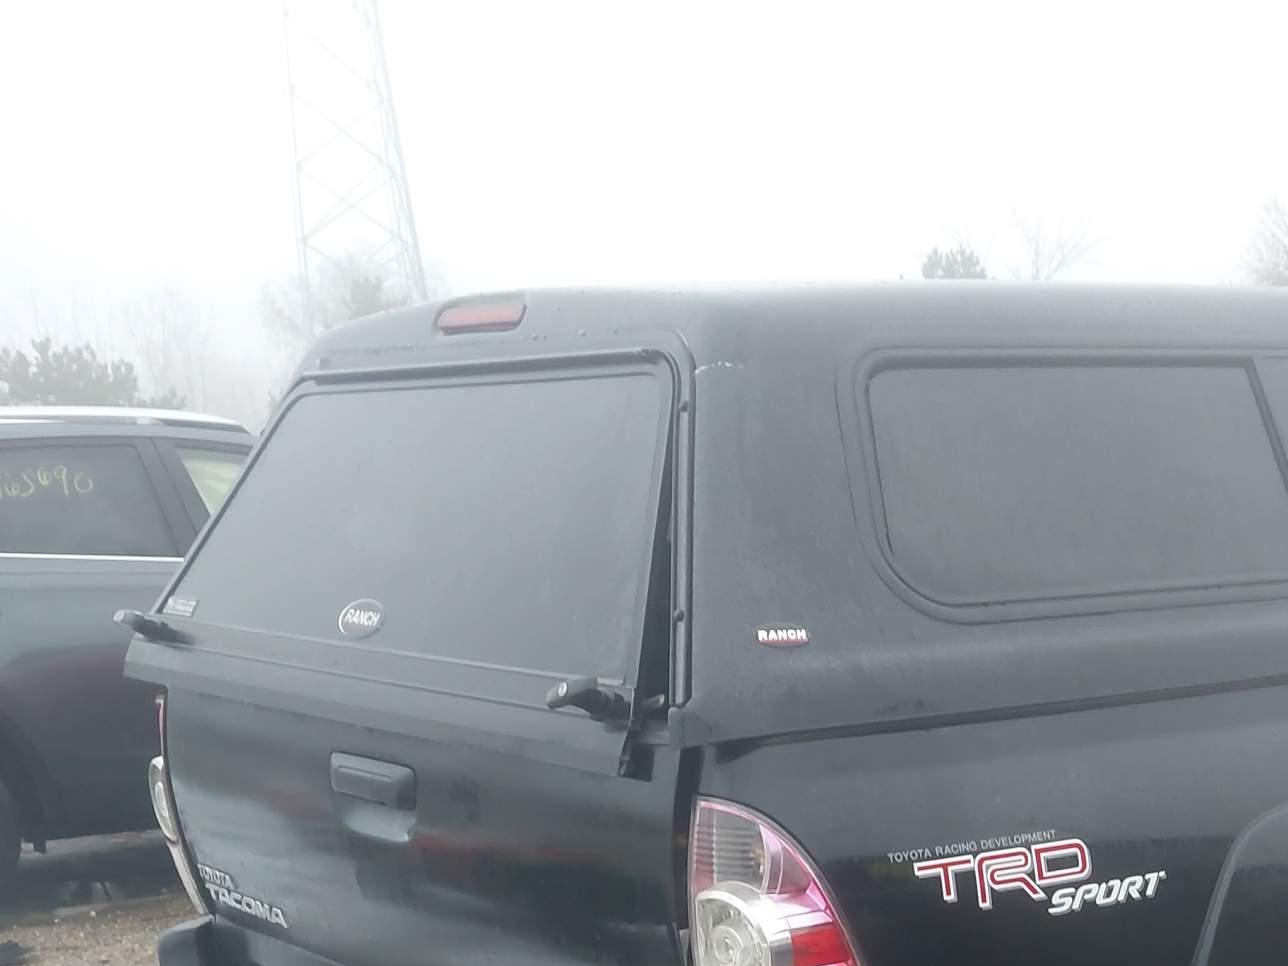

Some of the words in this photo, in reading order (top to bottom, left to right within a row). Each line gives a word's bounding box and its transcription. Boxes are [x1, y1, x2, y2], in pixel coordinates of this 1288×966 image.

[343, 608, 381, 627] RANCH
[757, 628, 808, 641] RANCH
[887, 848, 933, 864] TOYOTA
[934, 840, 978, 856] RACING
[980, 829, 1057, 850] DEVELOPMENT
[197, 863, 235, 890] TOYOTA
[913, 838, 1092, 911] TRD
[205, 881, 288, 929] TACOMA
[1048, 870, 1168, 916] SPORT
